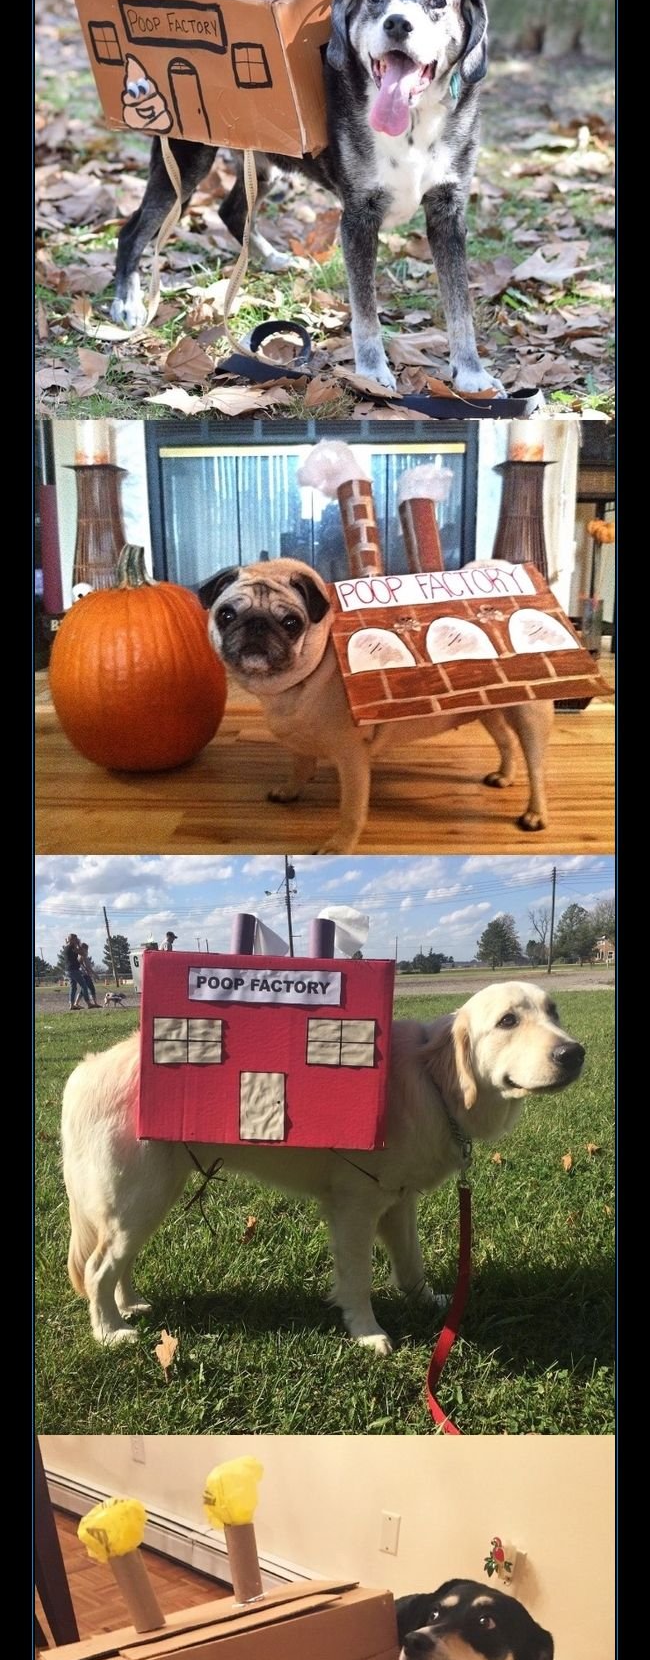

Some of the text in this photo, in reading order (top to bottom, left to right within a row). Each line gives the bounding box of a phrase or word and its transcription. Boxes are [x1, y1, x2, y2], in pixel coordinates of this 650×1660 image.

[127, 9, 218, 37] POOP FACTORY
[338, 567, 524, 607] POOP FACTORY
[196, 976, 331, 994] POOP FACTORY
